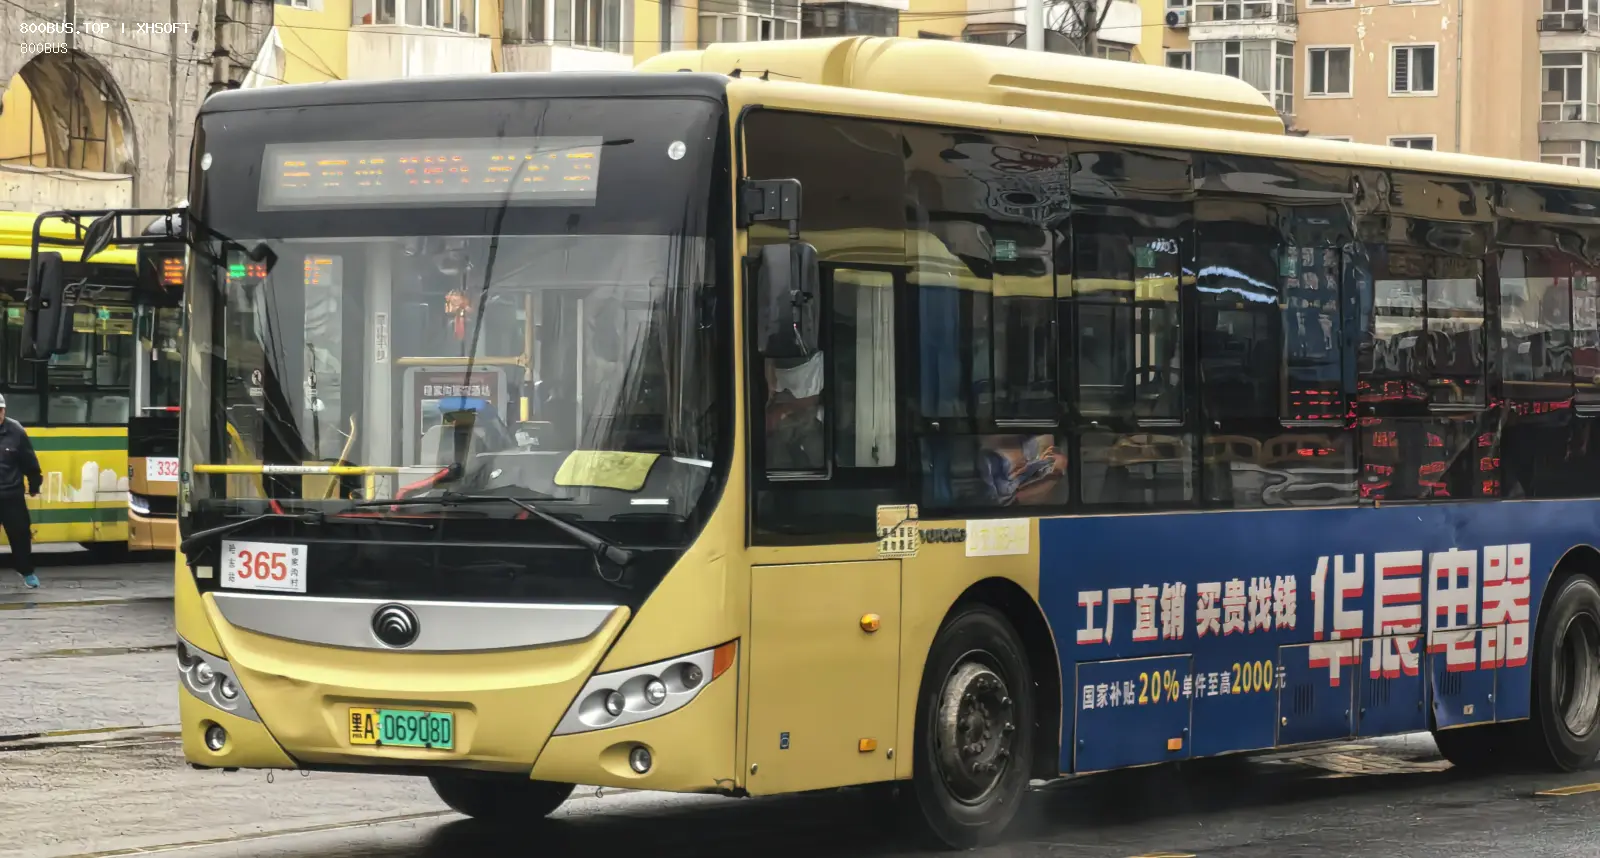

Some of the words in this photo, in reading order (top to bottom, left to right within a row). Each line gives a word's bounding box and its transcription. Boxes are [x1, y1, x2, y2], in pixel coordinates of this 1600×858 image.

[156, 461, 179, 476] 332
[237, 550, 288, 581] 365
[1076, 582, 1187, 645] 工厂直销
[1196, 575, 1297, 638] 买贵找钱
[1308, 543, 1531, 687] 华辰电器
[384, 715, 451, 744] 06908D
